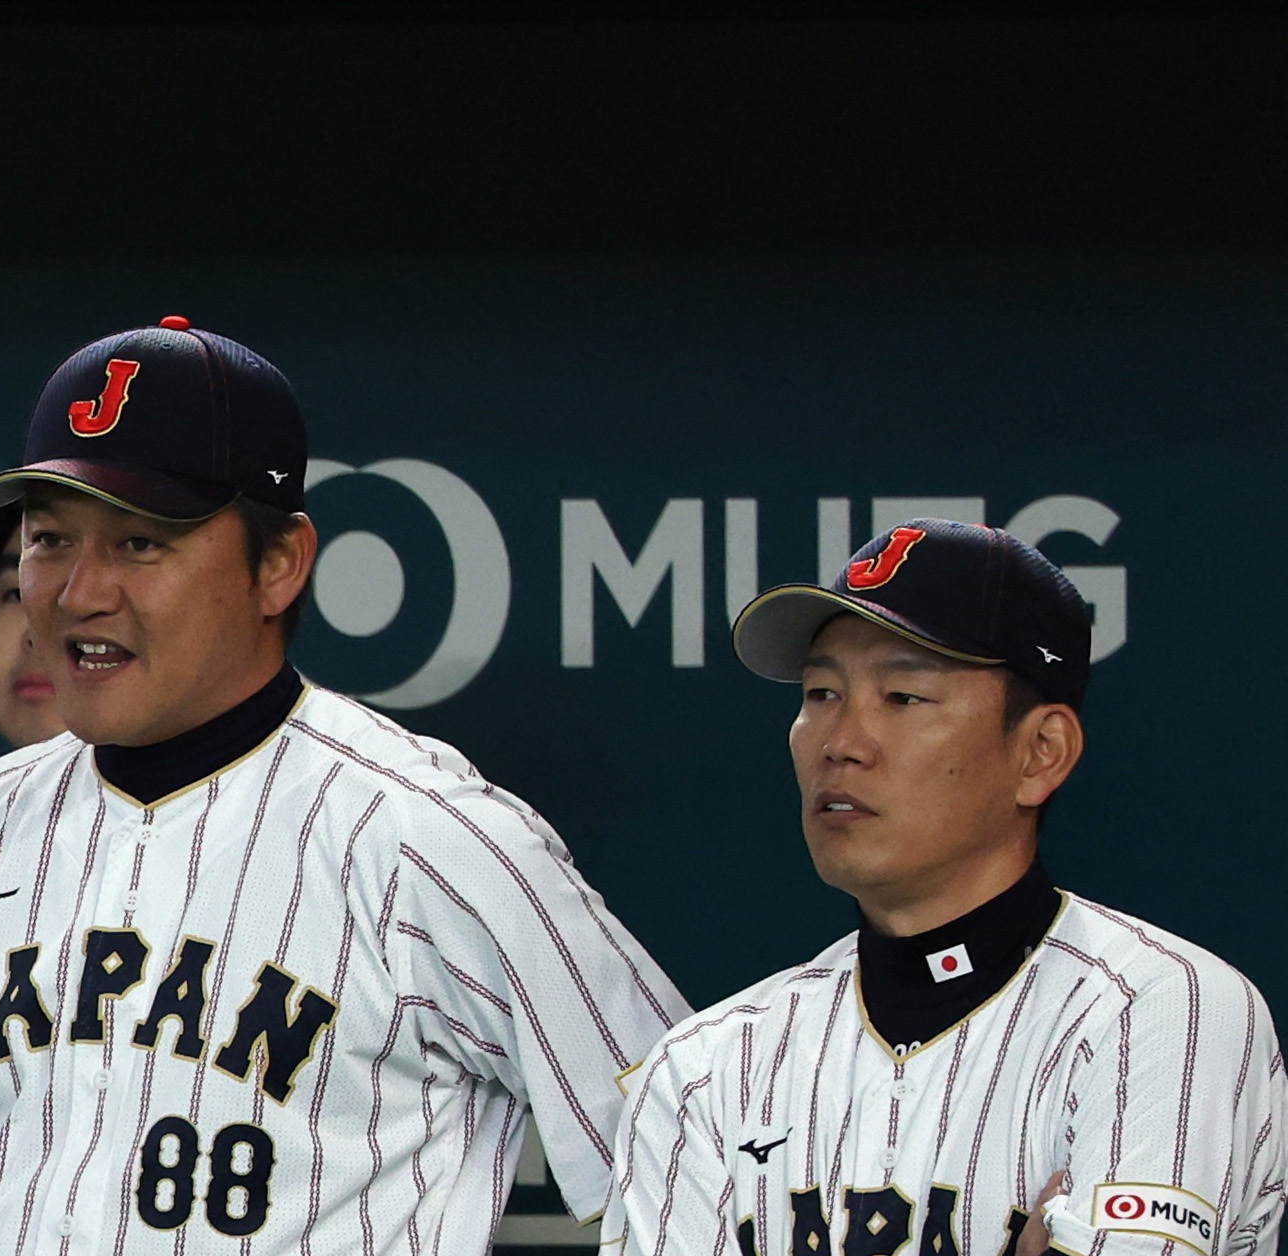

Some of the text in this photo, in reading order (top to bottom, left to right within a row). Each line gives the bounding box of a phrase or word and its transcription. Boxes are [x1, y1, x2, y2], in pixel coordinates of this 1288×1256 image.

[68, 358, 140, 438] J
[846, 526, 927, 591] J
[136, 1113, 278, 1239] 88
[1150, 1199, 1212, 1241] MUFG
